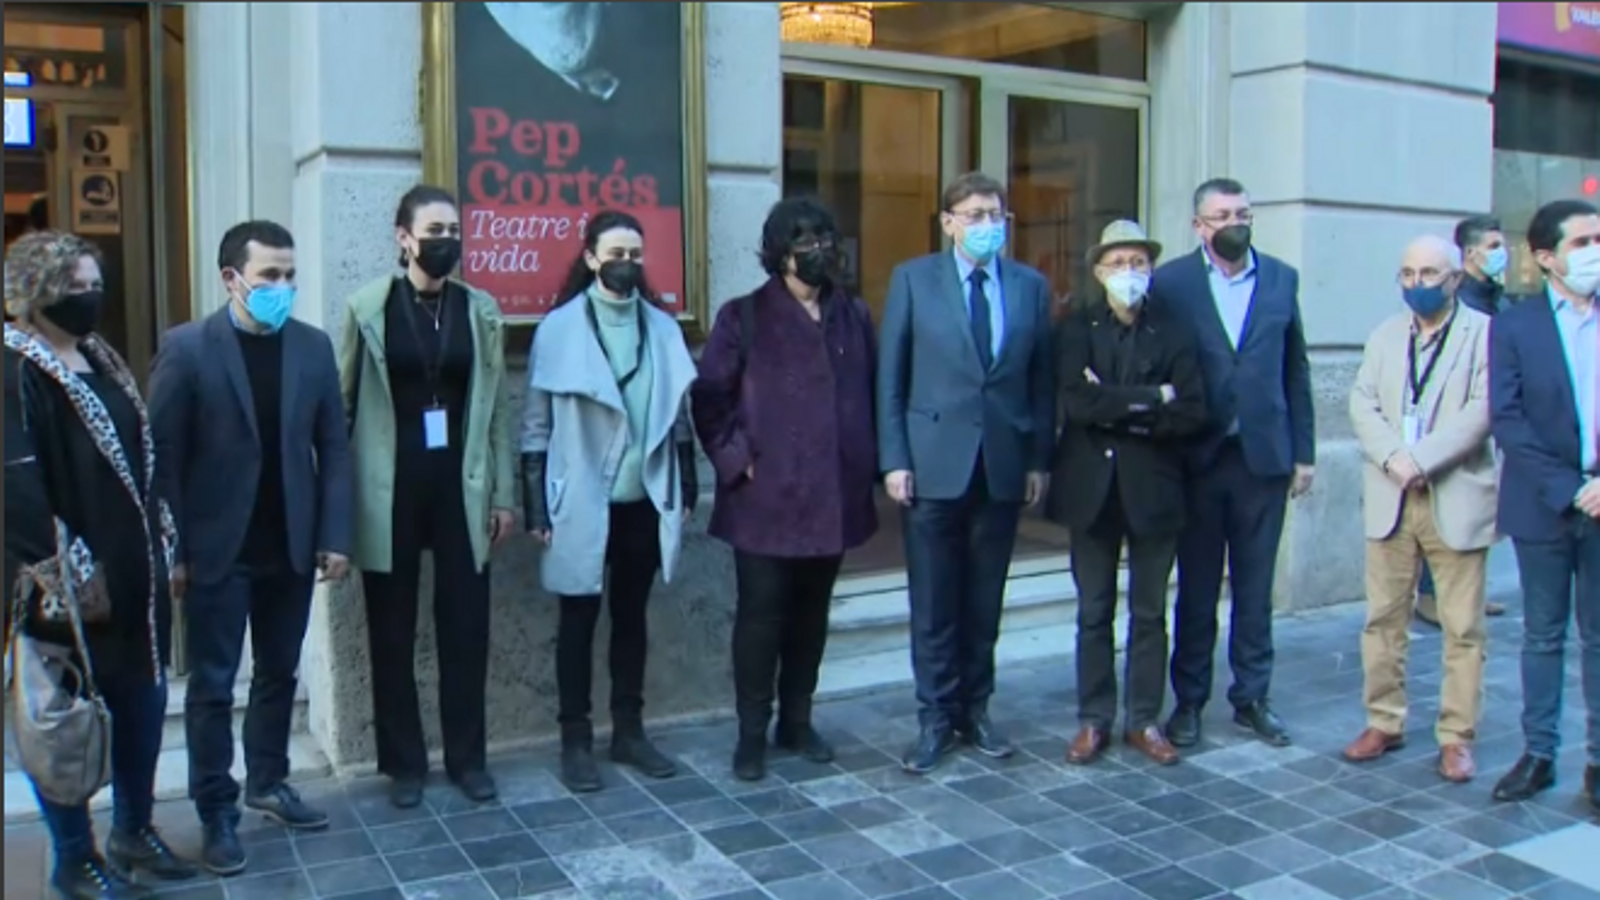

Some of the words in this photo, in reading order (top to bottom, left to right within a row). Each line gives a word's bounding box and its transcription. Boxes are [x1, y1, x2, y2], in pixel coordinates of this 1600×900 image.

[468, 106, 580, 168] Pep
[466, 157, 659, 206] Cortés
[470, 209, 571, 240] Teatre
[576, 212, 590, 241] i
[469, 244, 541, 273] vida
